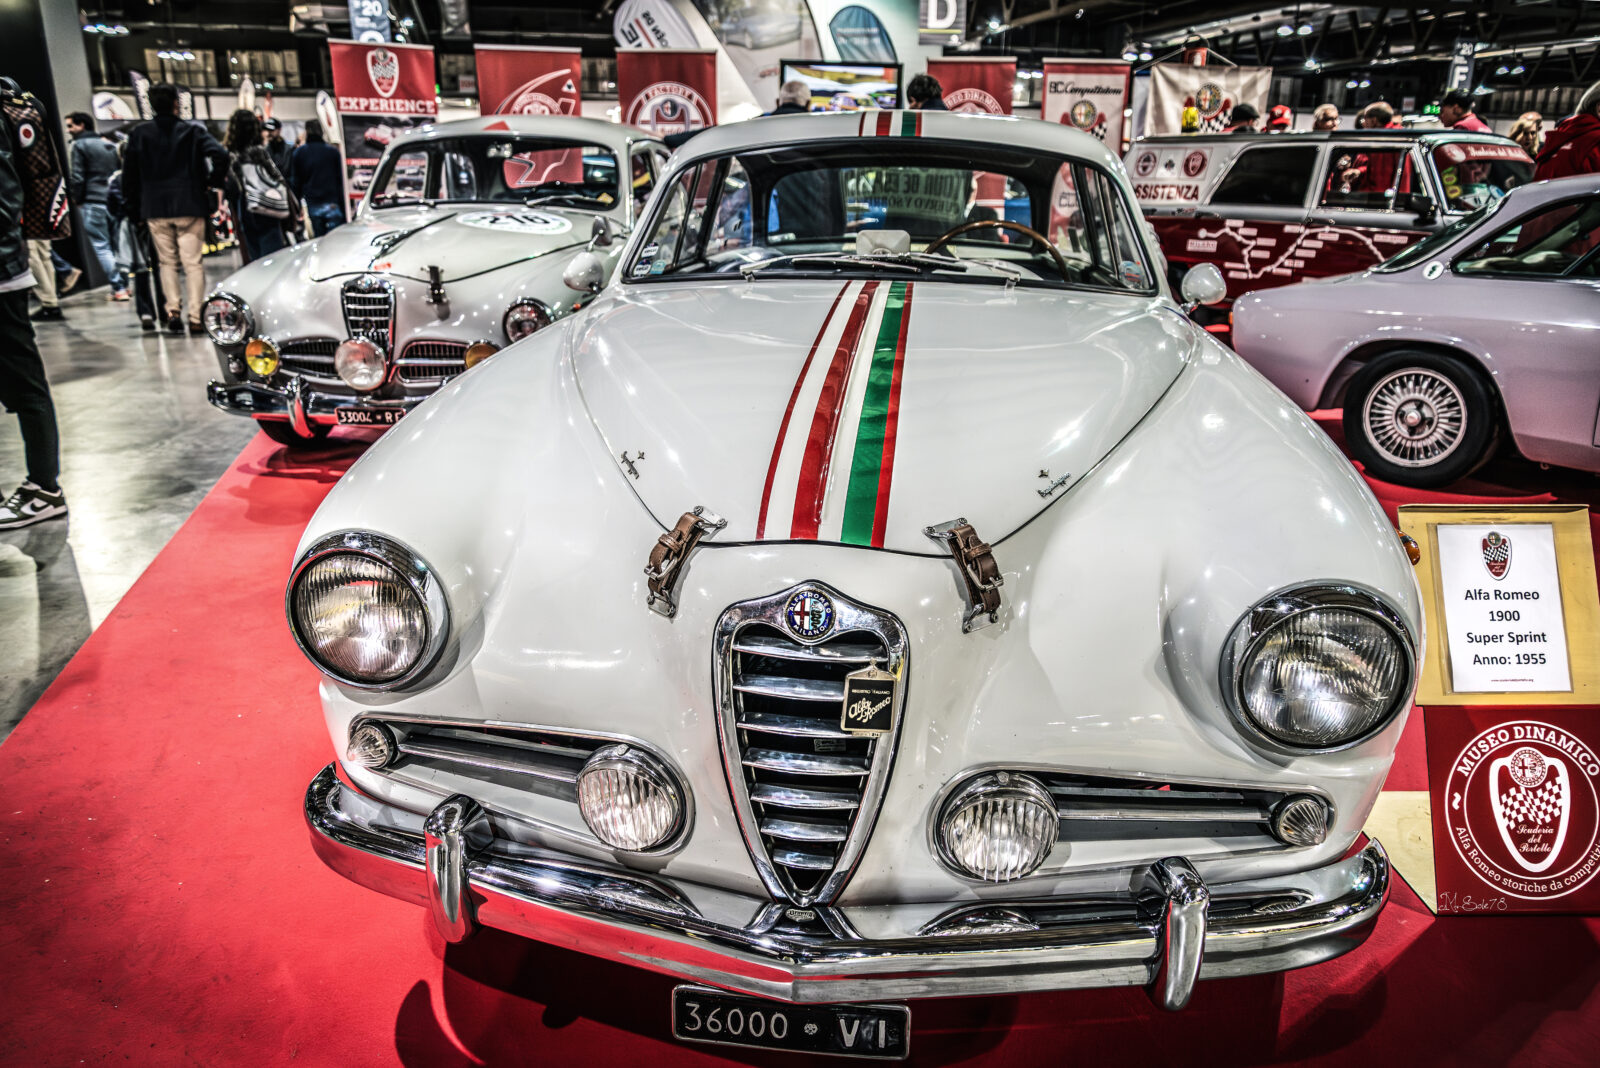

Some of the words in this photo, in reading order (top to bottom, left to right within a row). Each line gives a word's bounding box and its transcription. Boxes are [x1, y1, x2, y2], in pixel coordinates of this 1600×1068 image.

[927, 0, 957, 29] D
[1451, 65, 1469, 90] F
[339, 97, 435, 113] EXPERIENCE
[1135, 184, 1199, 201] SSISTENZA
[1464, 589, 1490, 601] Alfa
[1494, 589, 1540, 600] Romeo
[1489, 610, 1521, 622] 1900
[793, 624, 826, 636] MILANO
[1466, 632, 1504, 646] Super
[1508, 631, 1547, 646] Sprint
[1473, 653, 1512, 665] Anno:
[1515, 653, 1547, 665] 1955
[1456, 729, 1510, 777] MUSEO
[1513, 725, 1599, 777] DINAMICO
[1516, 824, 1554, 834] Scuderia
[1528, 834, 1541, 844] del
[1519, 843, 1552, 853] Portello
[1455, 826, 1471, 850] Alfa
[1468, 848, 1502, 882] Romeo
[1502, 876, 1548, 893] storiche
[1550, 880, 1564, 891] da
[684, 1002, 788, 1040] 36000
[839, 1018, 887, 1049] VI
